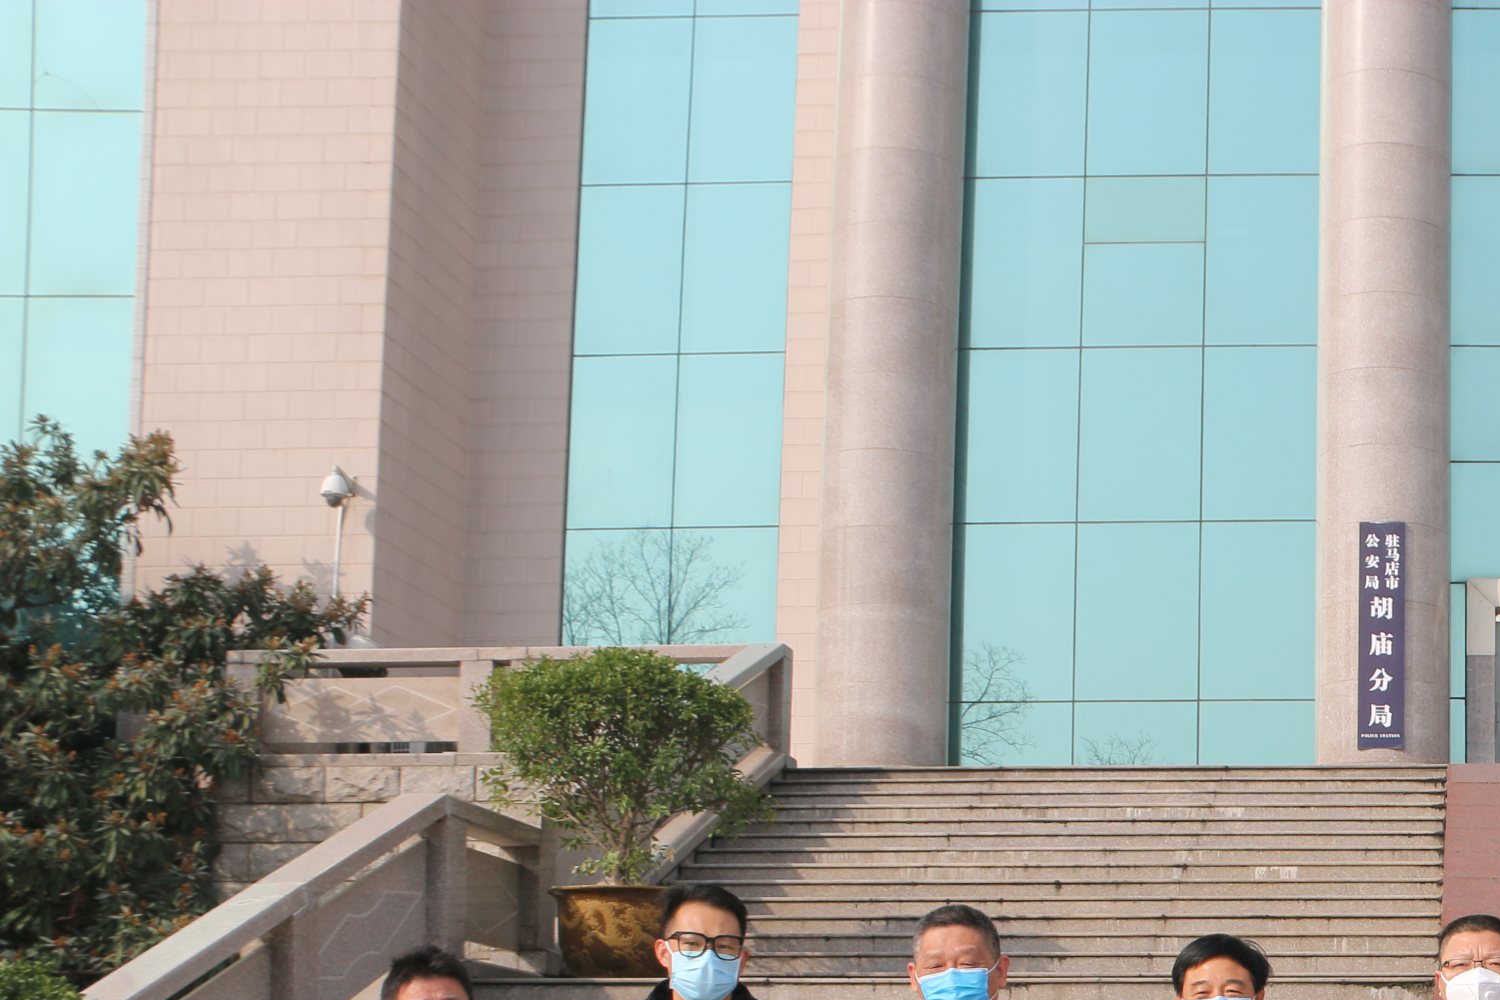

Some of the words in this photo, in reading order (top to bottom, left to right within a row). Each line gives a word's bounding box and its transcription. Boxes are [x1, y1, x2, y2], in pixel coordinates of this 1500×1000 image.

[1365, 533, 1380, 590] 公安局
[1385, 533, 1400, 590] 驻马店市
[1369, 597, 1393, 728] 胡庙分局
